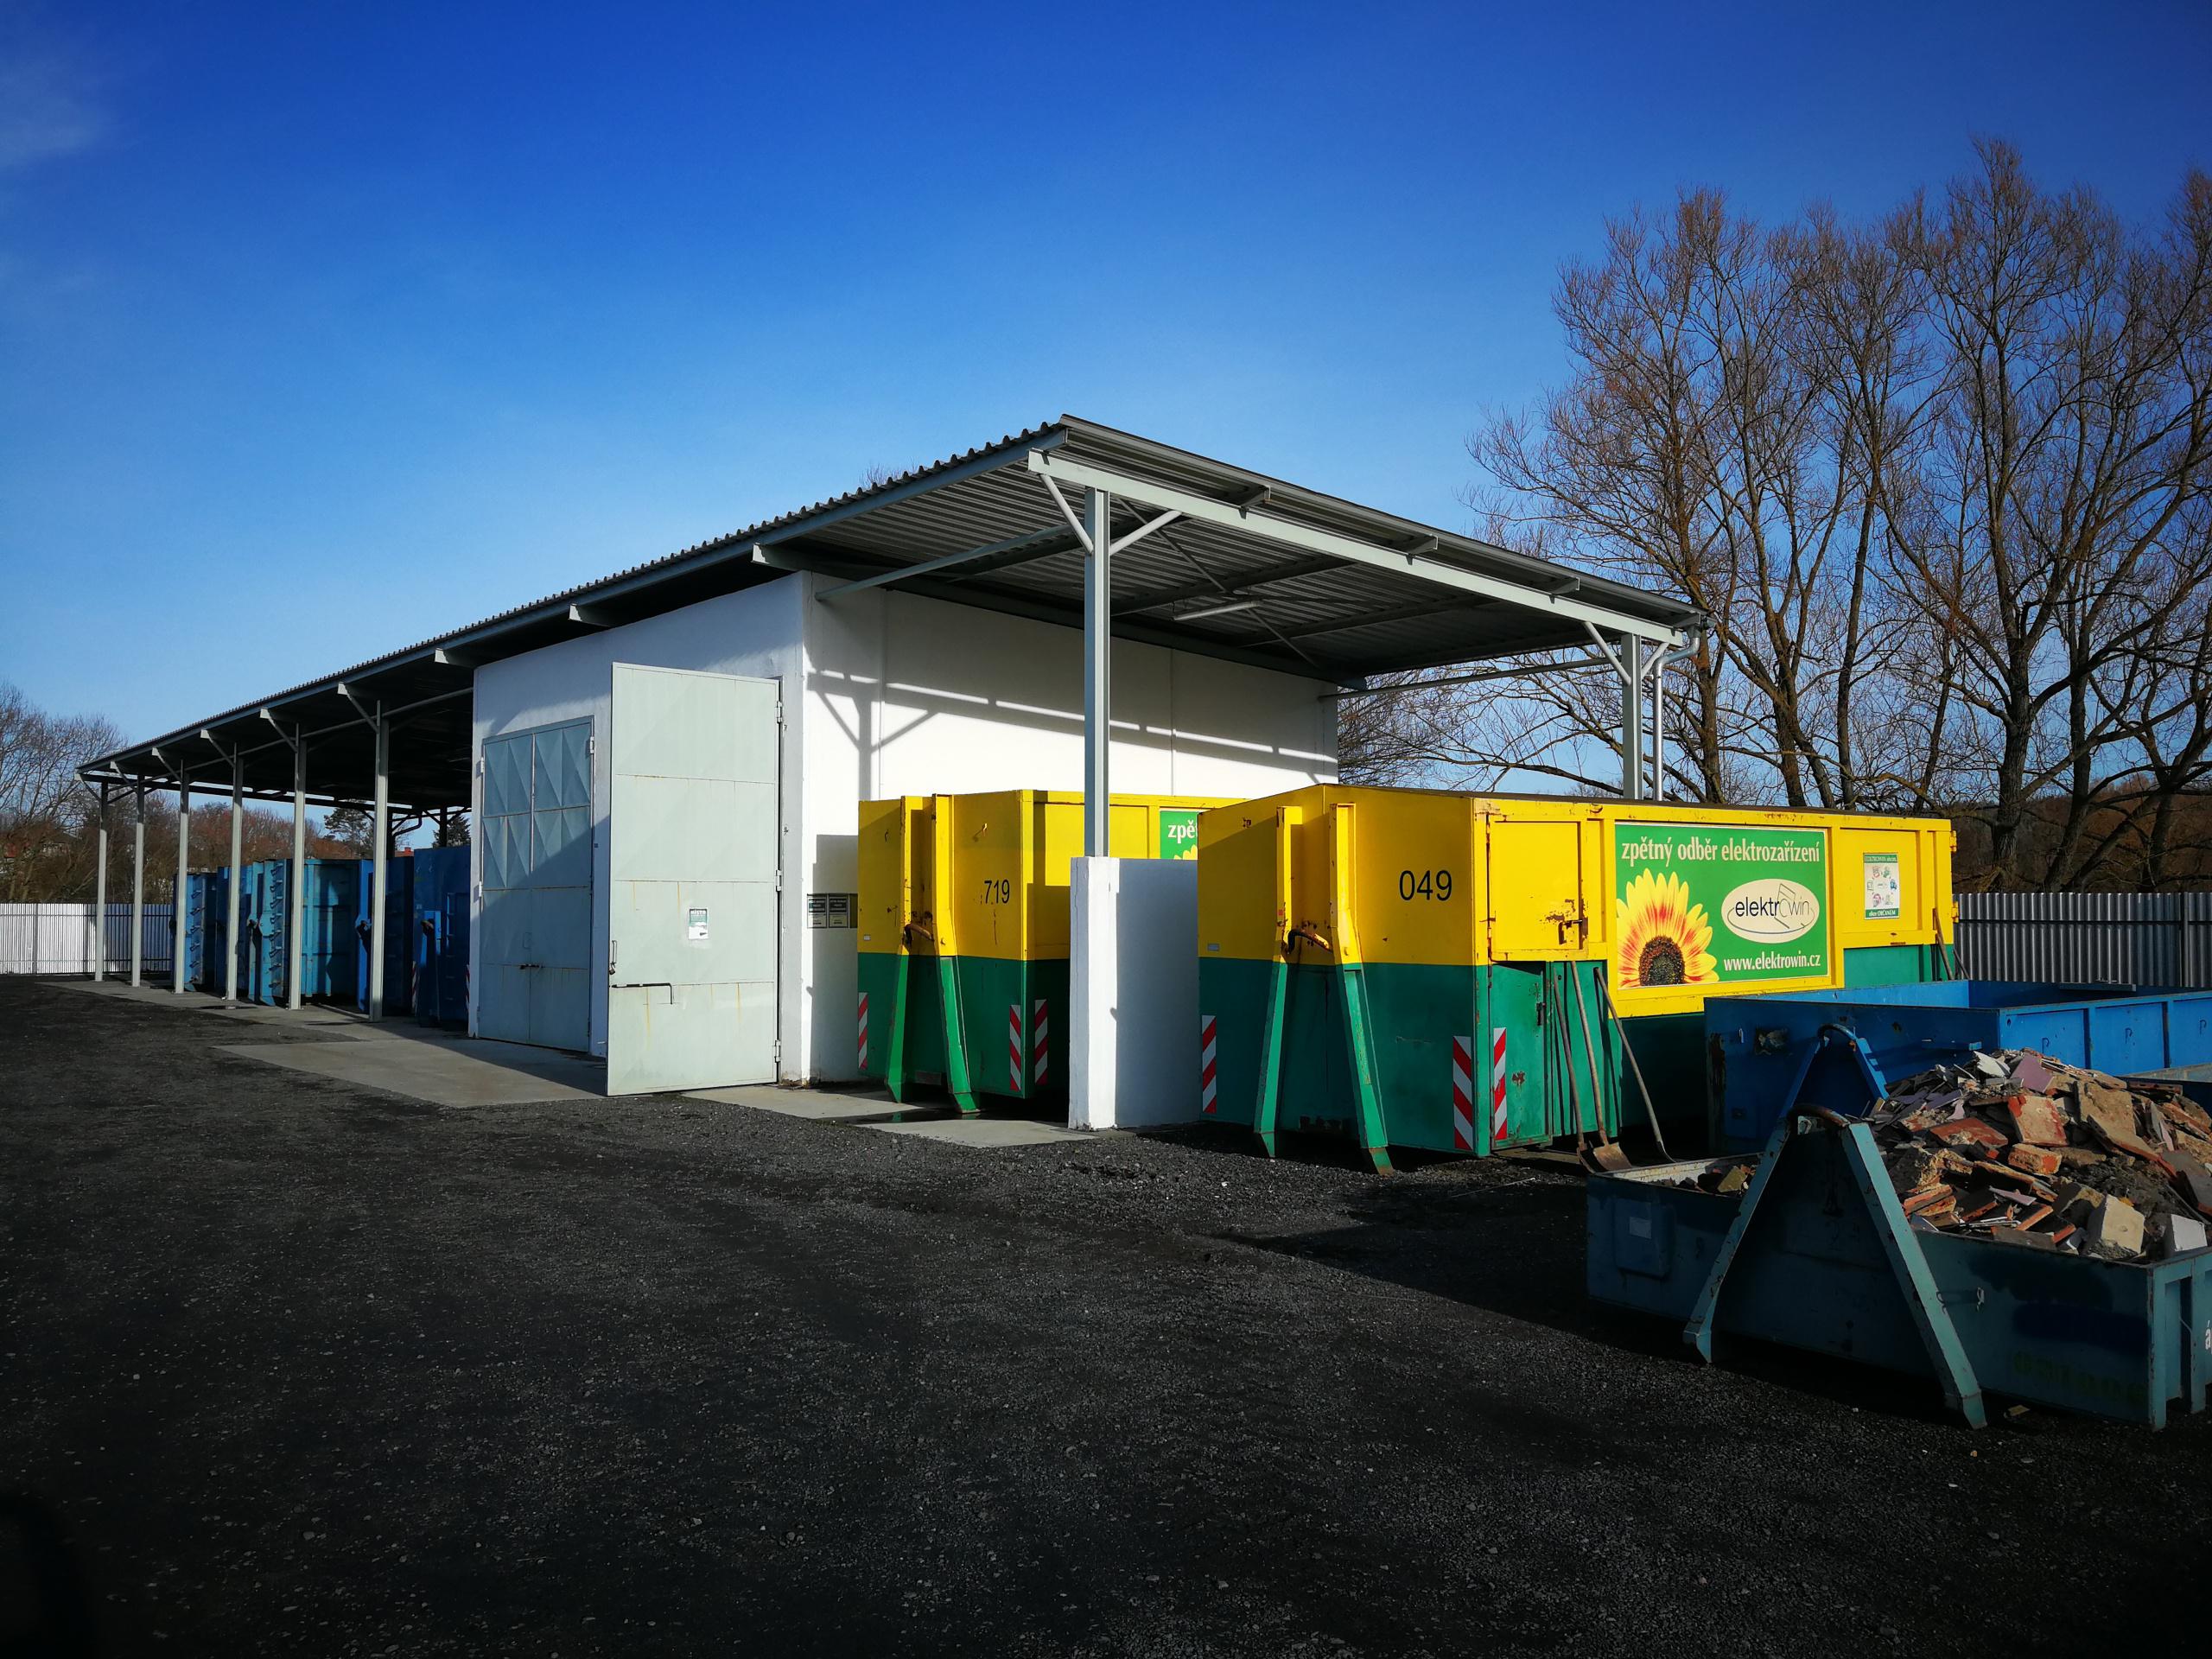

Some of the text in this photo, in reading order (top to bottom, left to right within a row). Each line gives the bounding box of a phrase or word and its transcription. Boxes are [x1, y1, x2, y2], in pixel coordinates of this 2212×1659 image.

[1167, 819, 1198, 844] zpě
[1621, 836, 1820, 868] zpětný odběr elektrozařízení
[984, 879, 1010, 904] 719
[1399, 869, 1452, 901] 049
[1723, 950, 1821, 971] www.elektrowin.cz
